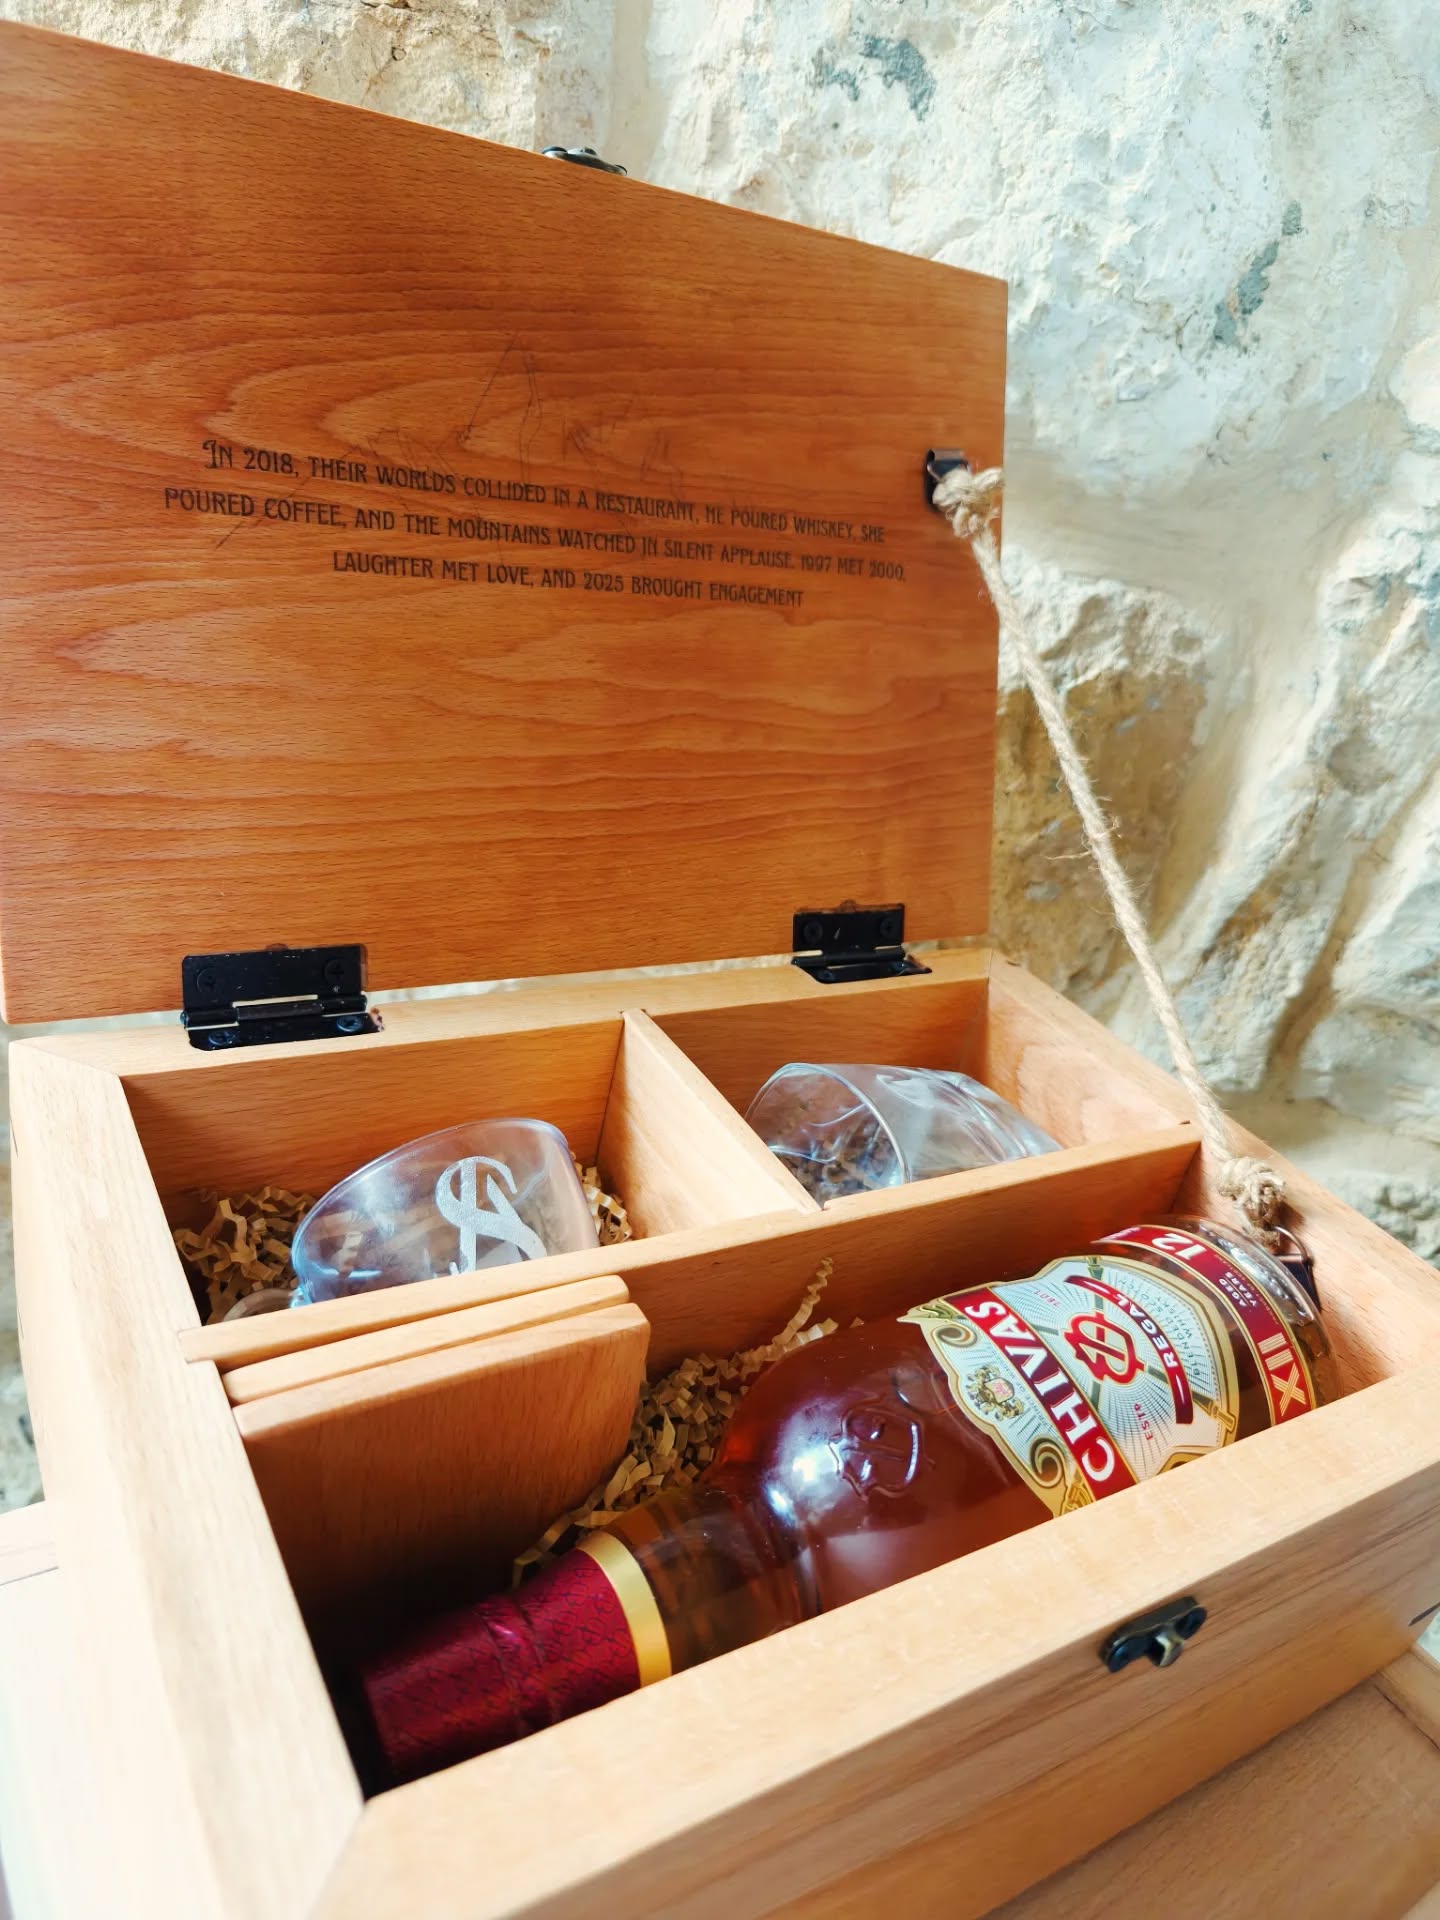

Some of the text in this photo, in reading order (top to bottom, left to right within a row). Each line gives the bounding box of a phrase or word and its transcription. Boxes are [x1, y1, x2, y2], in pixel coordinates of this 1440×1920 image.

[243, 449, 299, 477] 2018,
[307, 455, 367, 483] THEIR
[376, 466, 455, 494] WORLDS
[463, 476, 546, 504] COLLIDED
[554, 487, 570, 508] IN
[577, 489, 589, 511] A
[705, 504, 725, 525] HE
[731, 509, 788, 532] POURED
[861, 524, 885, 543] SHE
[165, 487, 255, 517] POURED
[264, 498, 347, 528] COFFEE,
[355, 508, 395, 530] AND
[404, 513, 441, 536] THE
[448, 518, 550, 545] MOUNTAINS
[557, 528, 635, 554] WATCHED
[642, 536, 657, 557] IN
[664, 539, 713, 561] SILENT
[801, 554, 832, 573] 1997
[837, 556, 864, 577] MET
[333, 551, 804, 608] LAUGHTER MET LOVE, AND 2025 BROUGHT ENGAGEMENT
[1151, 1232, 1207, 1261] 12
[1218, 1278, 1248, 1307] AGED
[1224, 1271, 1258, 1307] YEARS
[1116, 1293, 1179, 1369] REGAL
[1164, 1315, 1201, 1377] BLENDED
[965, 1299, 1117, 1482] CHIVAS
[1256, 1331, 1308, 1418] XII
